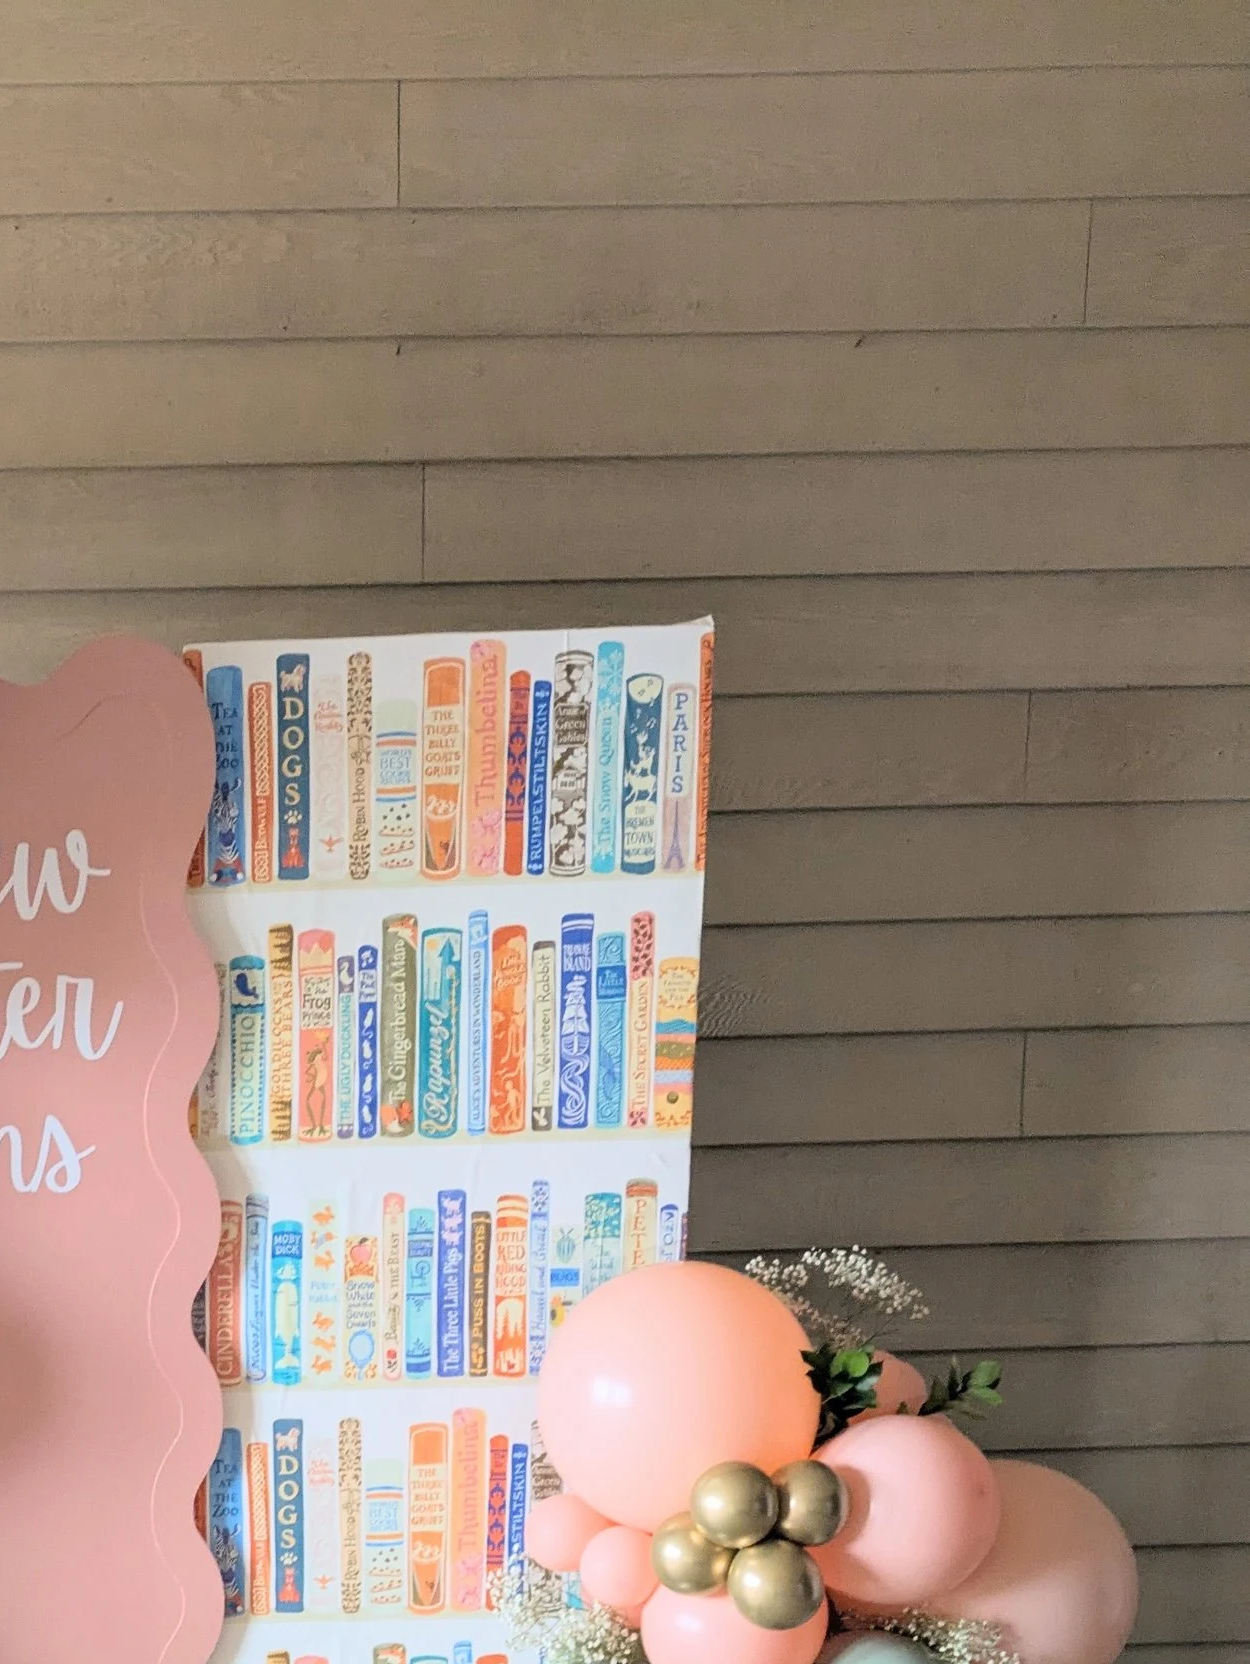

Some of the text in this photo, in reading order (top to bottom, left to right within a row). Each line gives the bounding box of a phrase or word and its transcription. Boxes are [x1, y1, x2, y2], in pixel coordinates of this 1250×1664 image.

[432, 710, 454, 721] THE
[217, 725, 232, 736] AT
[425, 724, 459, 736] THREE
[475, 653, 497, 807] Thumbelina
[281, 697, 305, 806] DOGS
[428, 739, 456, 750] BILLY
[671, 692, 689, 793] PARIS
[380, 757, 411, 769] BEST
[425, 753, 461, 764] GOATS
[425, 766, 461, 778] GRUFF
[598, 716, 614, 845] The Snow Queen
[530, 703, 547, 861] RUMPELSTILTSKIN
[625, 832, 654, 845] TOWN
[281, 980, 293, 1033] BEARS
[302, 994, 331, 1011] Frog
[388, 939, 412, 1104] The Gingerbread Man
[536, 954, 551, 1107] The Velveteen Rabbit
[632, 981, 648, 1109] THE SECRET GARDEN
[340, 995, 352, 1122] THE UGLY DUCKLING
[423, 1002, 450, 1121] Rapunzel
[239, 1015, 256, 1134] PINOCCHIO
[273, 1233, 301, 1246] MOBY
[631, 1200, 647, 1265] PETE
[274, 1245, 301, 1257] DICK
[497, 1245, 526, 1263] RED
[473, 1226, 486, 1337] PUSS IN BOOTS
[495, 1276, 526, 1288] HOOD
[443, 1247, 463, 1371] The Three Little Pigs
[214, 1459, 238, 1475] TEA
[417, 1468, 437, 1478] THE
[218, 1479, 232, 1488] AT
[458, 1421, 479, 1552] Thumbelina
[277, 1455, 300, 1549] DOGS
[414, 1492, 440, 1502] BILLY
[411, 1504, 445, 1514] GOATS
